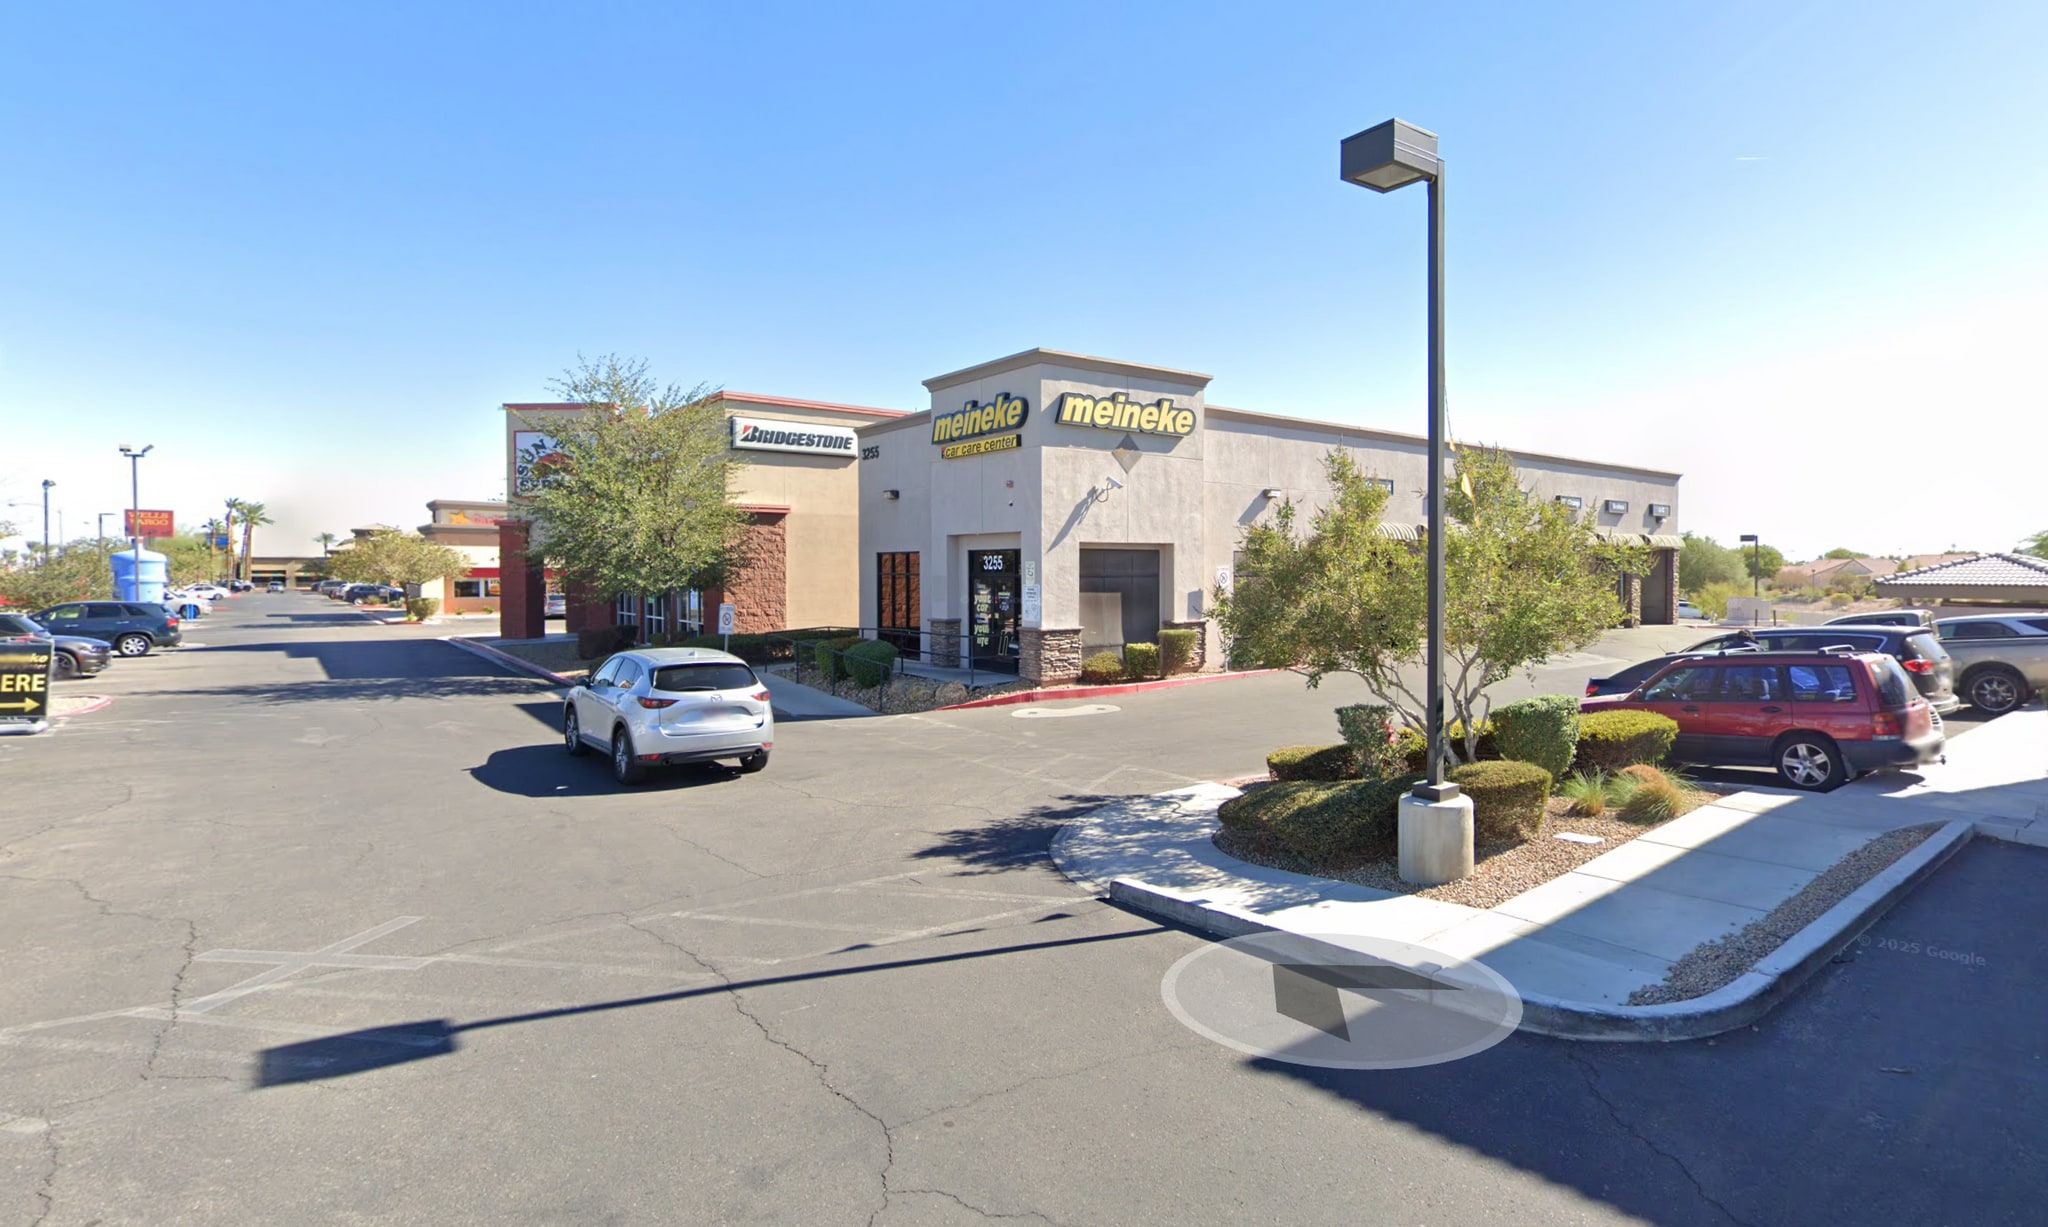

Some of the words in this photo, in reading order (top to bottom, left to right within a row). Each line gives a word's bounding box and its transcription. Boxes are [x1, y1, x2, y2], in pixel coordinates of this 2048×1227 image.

[934, 396, 1022, 442] meineke
[1062, 395, 1194, 434] meineke
[740, 425, 854, 450] BRIDGESTONE
[945, 446, 960, 458] car
[961, 443, 981, 455] care
[983, 436, 1017, 451] center
[862, 446, 880, 460] 3255
[127, 511, 169, 520] WELLS
[983, 555, 1003, 570] 3255
[0, 673, 46, 692] ERE
